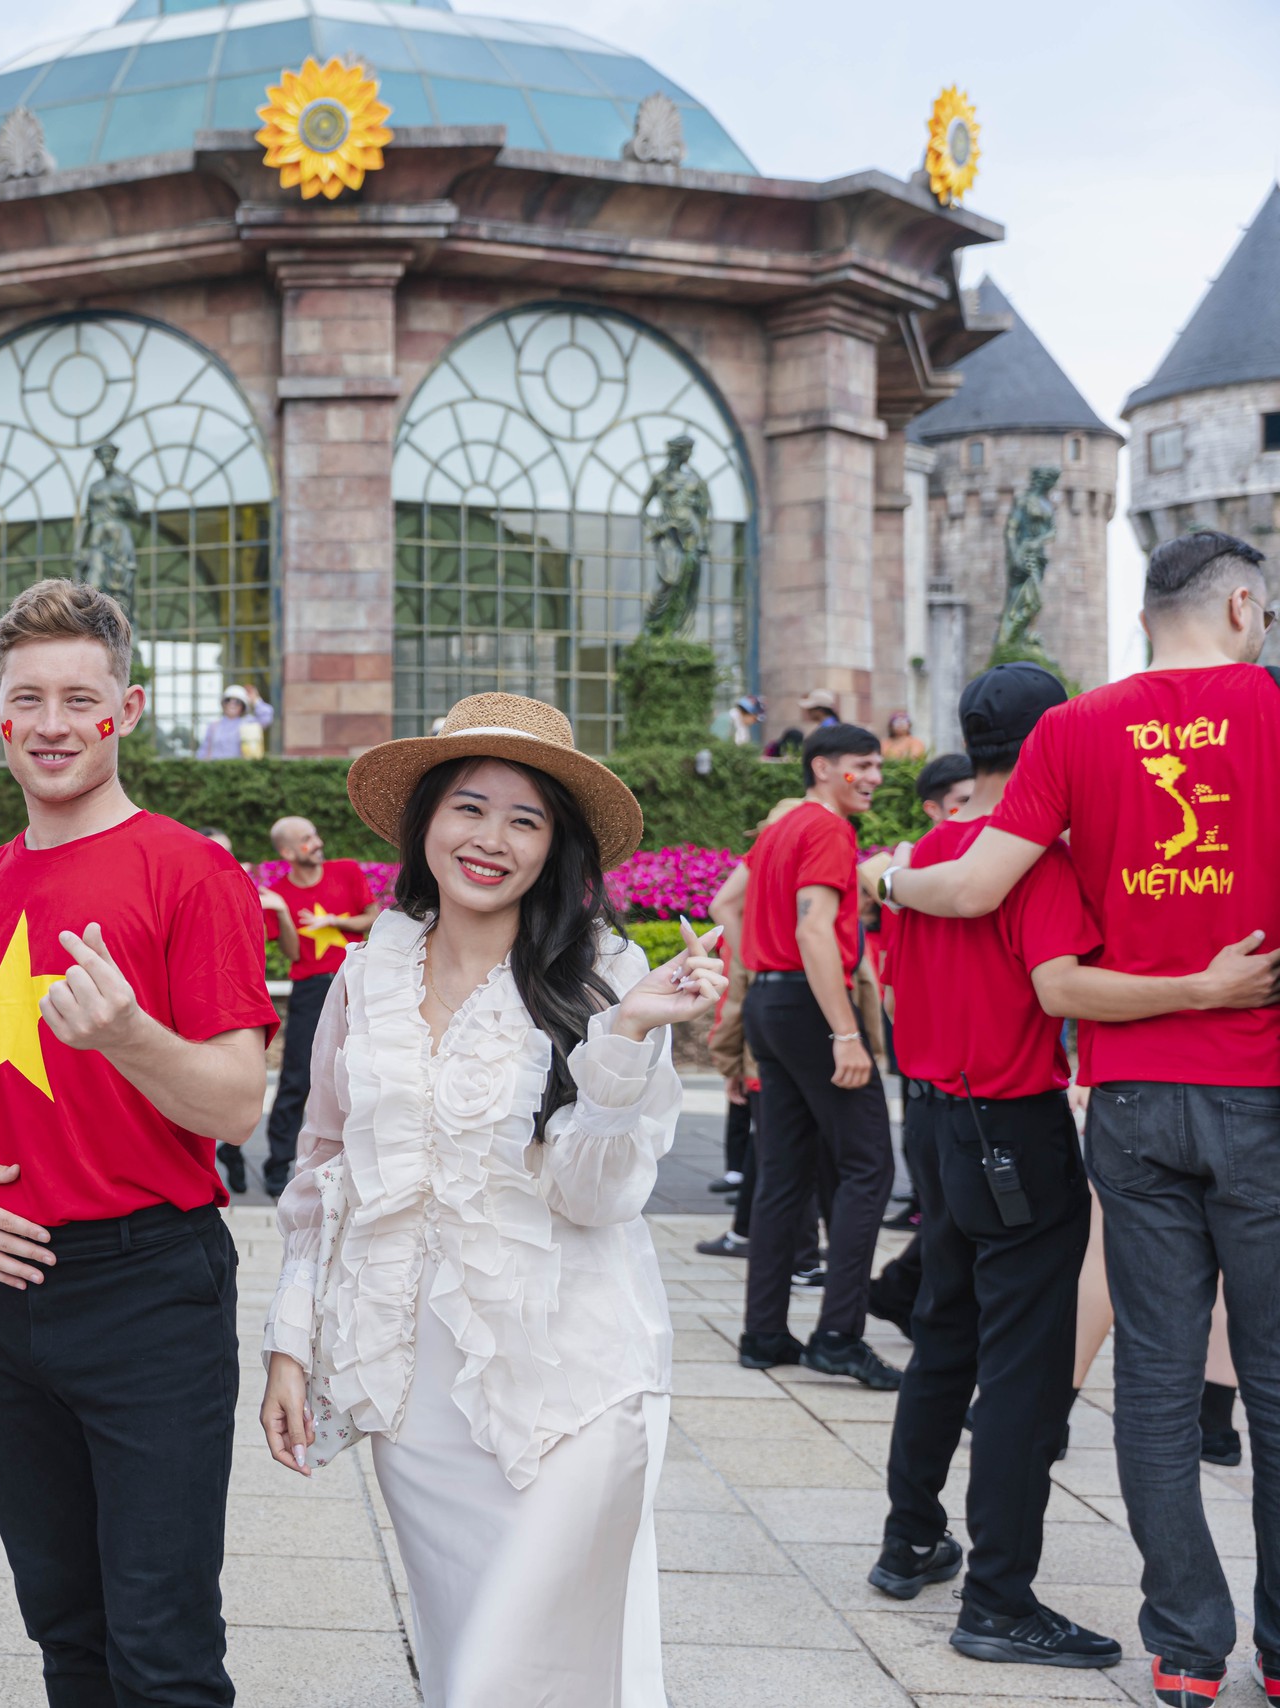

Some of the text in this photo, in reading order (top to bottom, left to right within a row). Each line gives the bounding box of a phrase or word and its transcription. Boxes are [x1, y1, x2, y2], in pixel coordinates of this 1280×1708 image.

[1126, 716, 1229, 750] TÔI YÊU
[1122, 862, 1234, 901] VIỆT NAM
